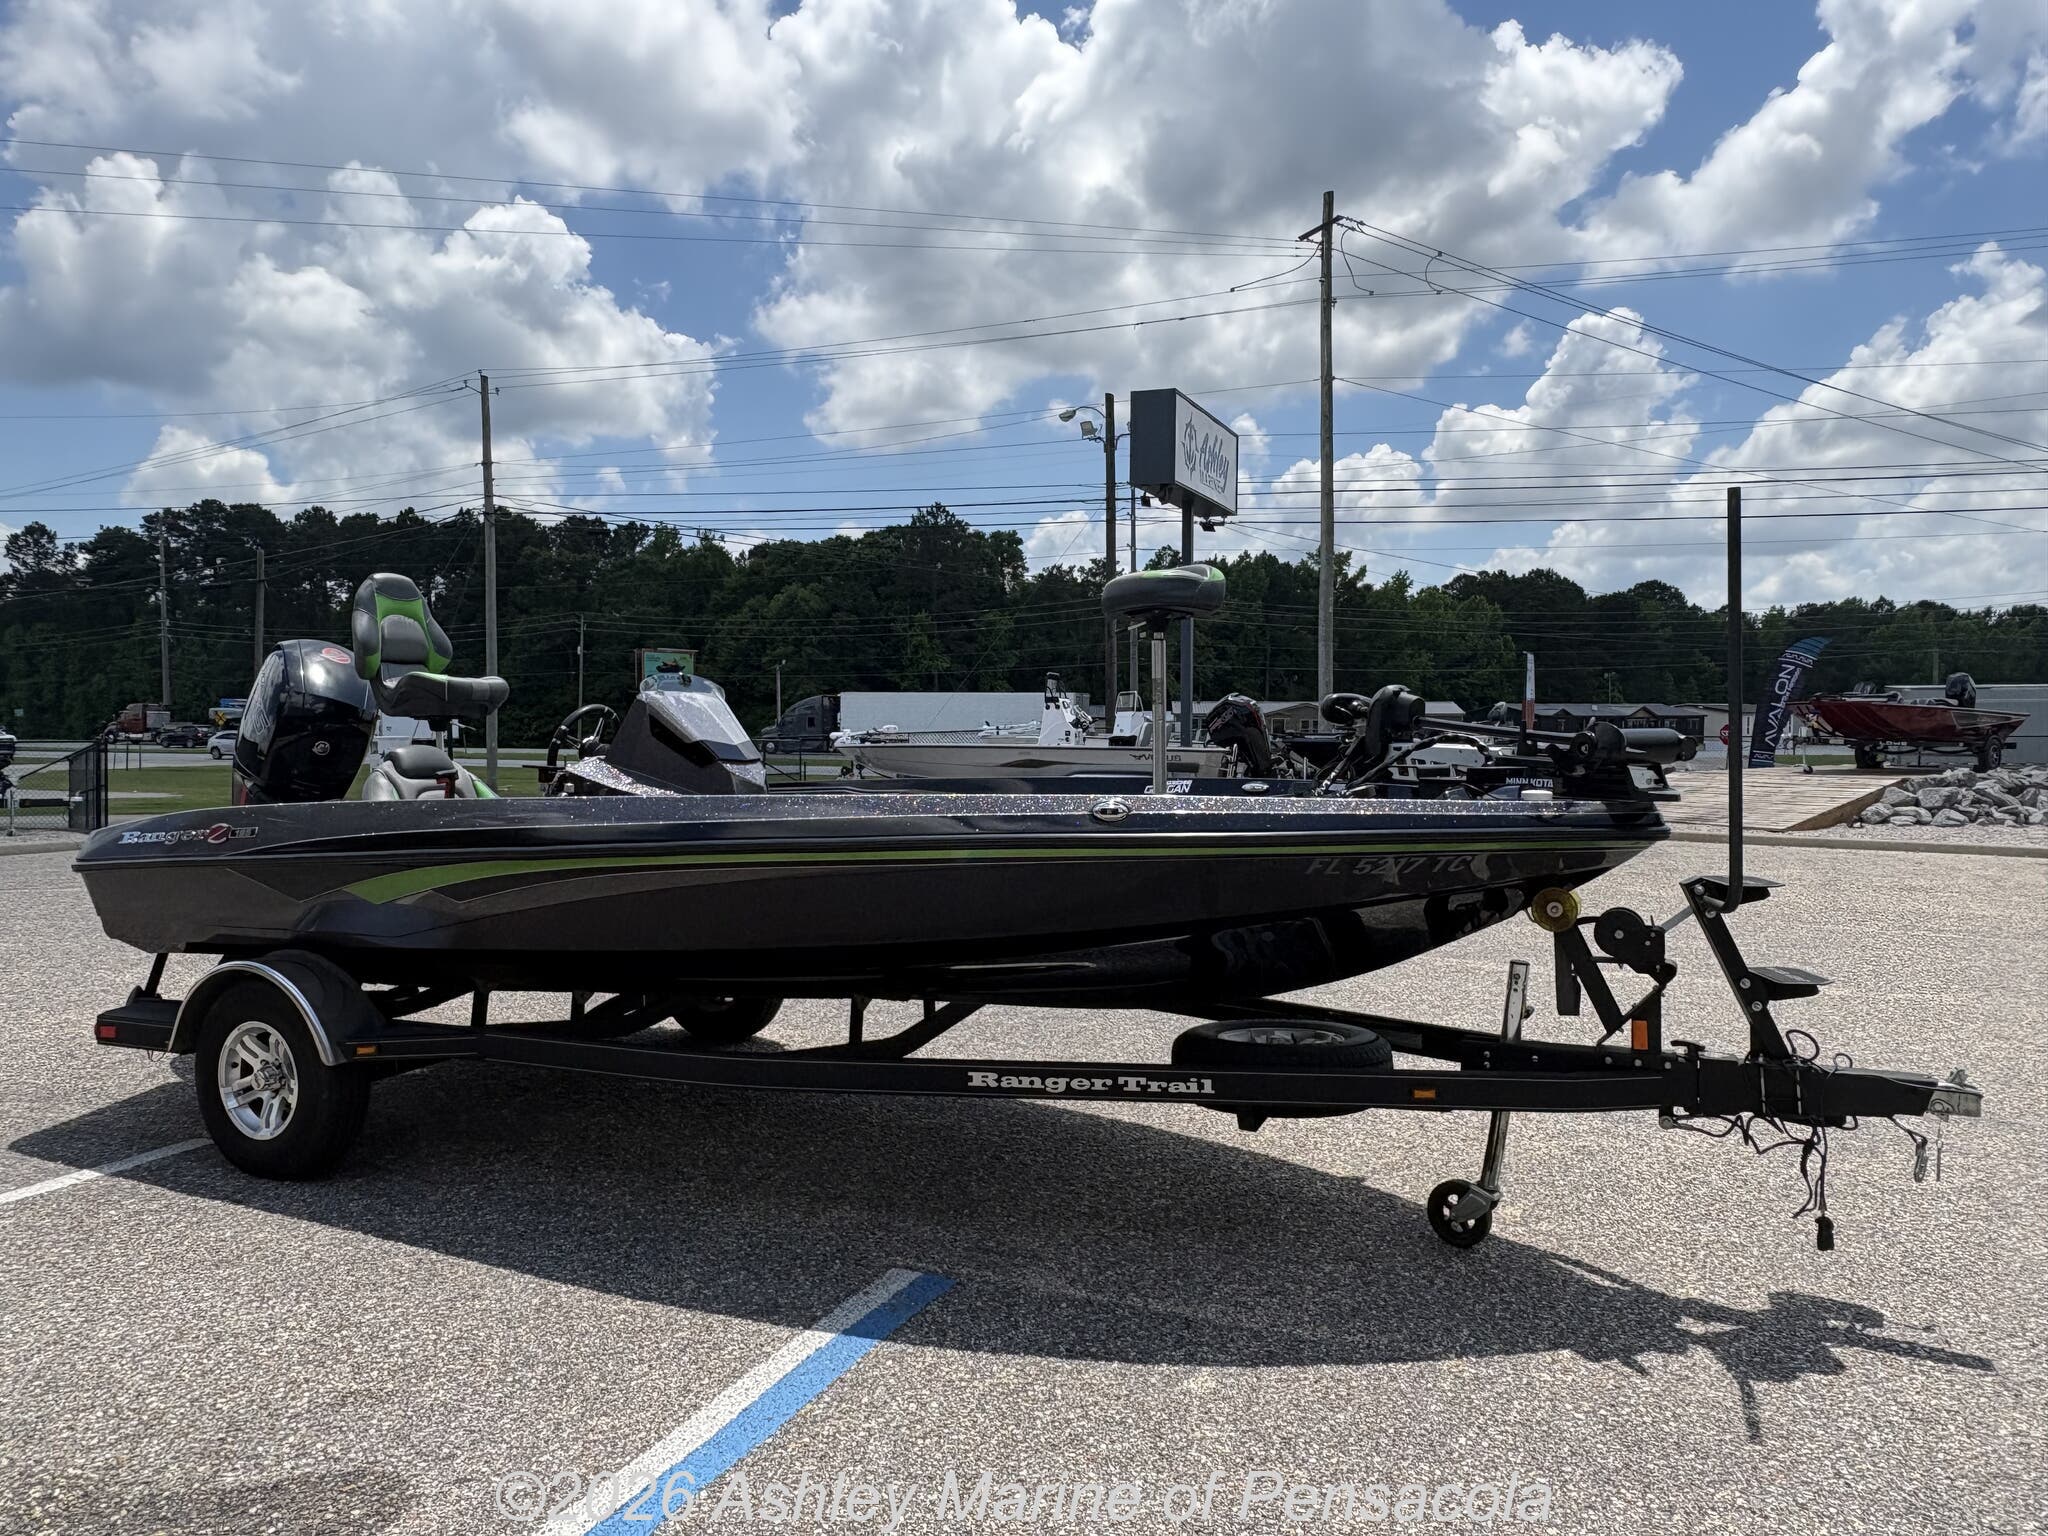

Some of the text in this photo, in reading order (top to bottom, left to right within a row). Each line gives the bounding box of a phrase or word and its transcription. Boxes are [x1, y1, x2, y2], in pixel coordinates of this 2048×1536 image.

[1199, 432, 1230, 494] Ashley
[1765, 664, 1796, 747] AVALON
[1505, 777, 1553, 788] MINN KOTA
[118, 829, 209, 844] Ranger
[1304, 858, 1341, 875] FL
[1431, 856, 1472, 873] TC
[967, 1071, 1215, 1094] Ranger Trail
